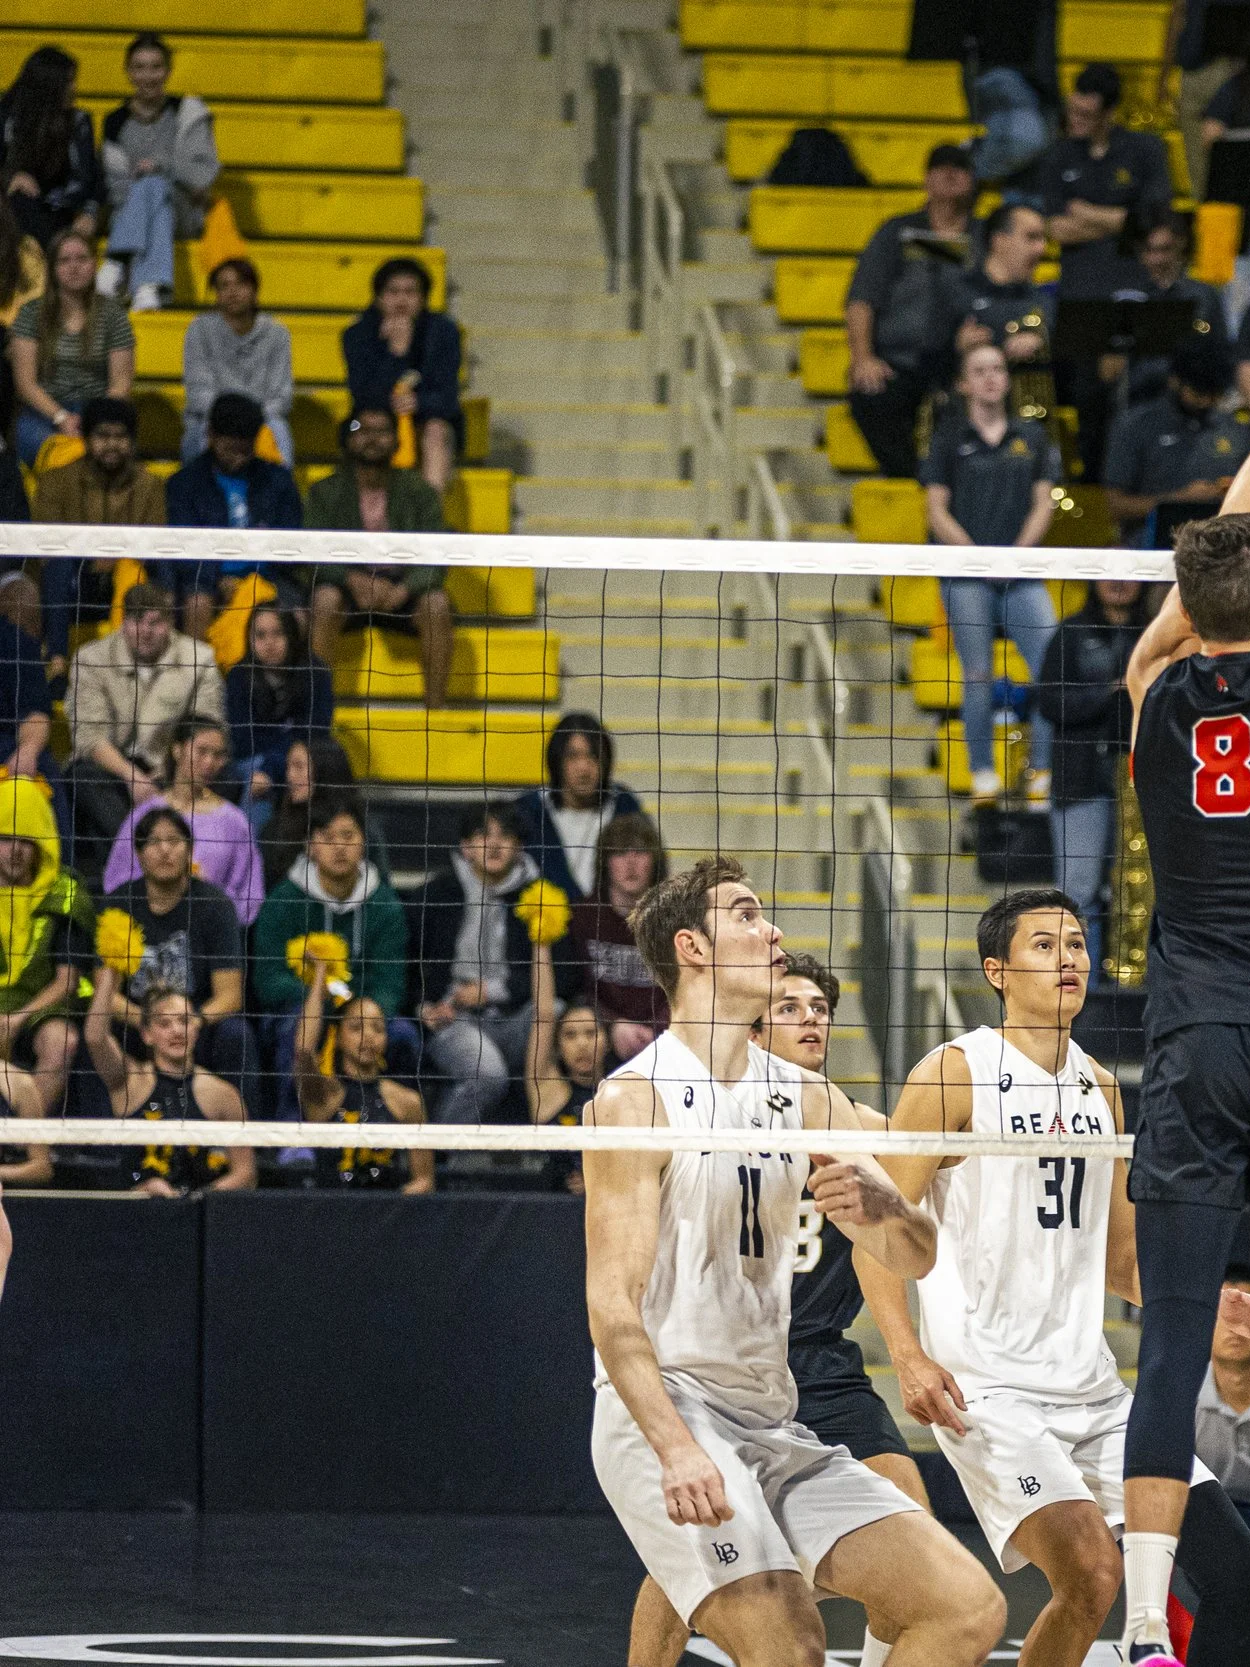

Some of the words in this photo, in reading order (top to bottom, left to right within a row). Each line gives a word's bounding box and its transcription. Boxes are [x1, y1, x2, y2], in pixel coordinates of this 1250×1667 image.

[1011, 1112, 1102, 1134] BEACH
[1037, 1157, 1085, 1229] 31
[738, 1165, 764, 1258] 11
[1017, 1475, 1041, 1497] LB
[711, 1541, 739, 1566] LB
